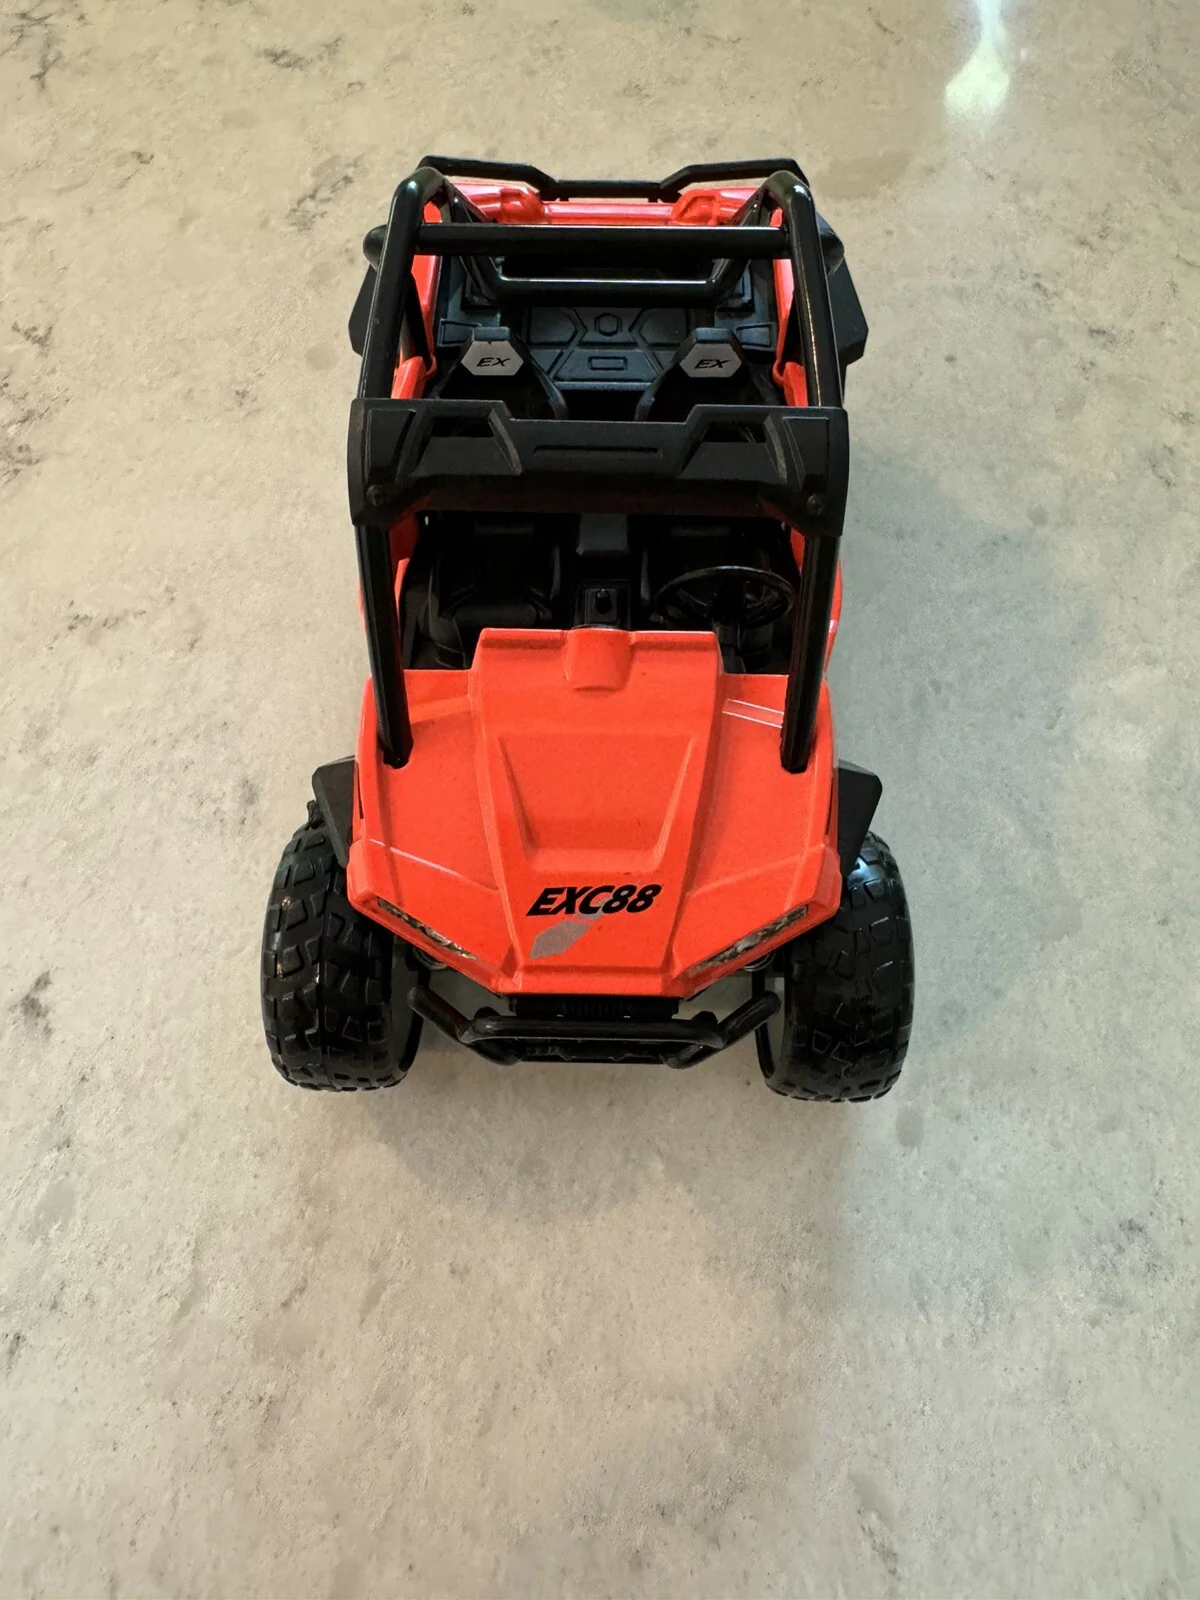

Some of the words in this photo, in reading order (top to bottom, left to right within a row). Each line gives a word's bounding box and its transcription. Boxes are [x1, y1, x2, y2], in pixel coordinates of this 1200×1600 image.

[476, 357, 511, 367] EX
[694, 358, 730, 369] EX
[526, 884, 662, 916] EXC88
